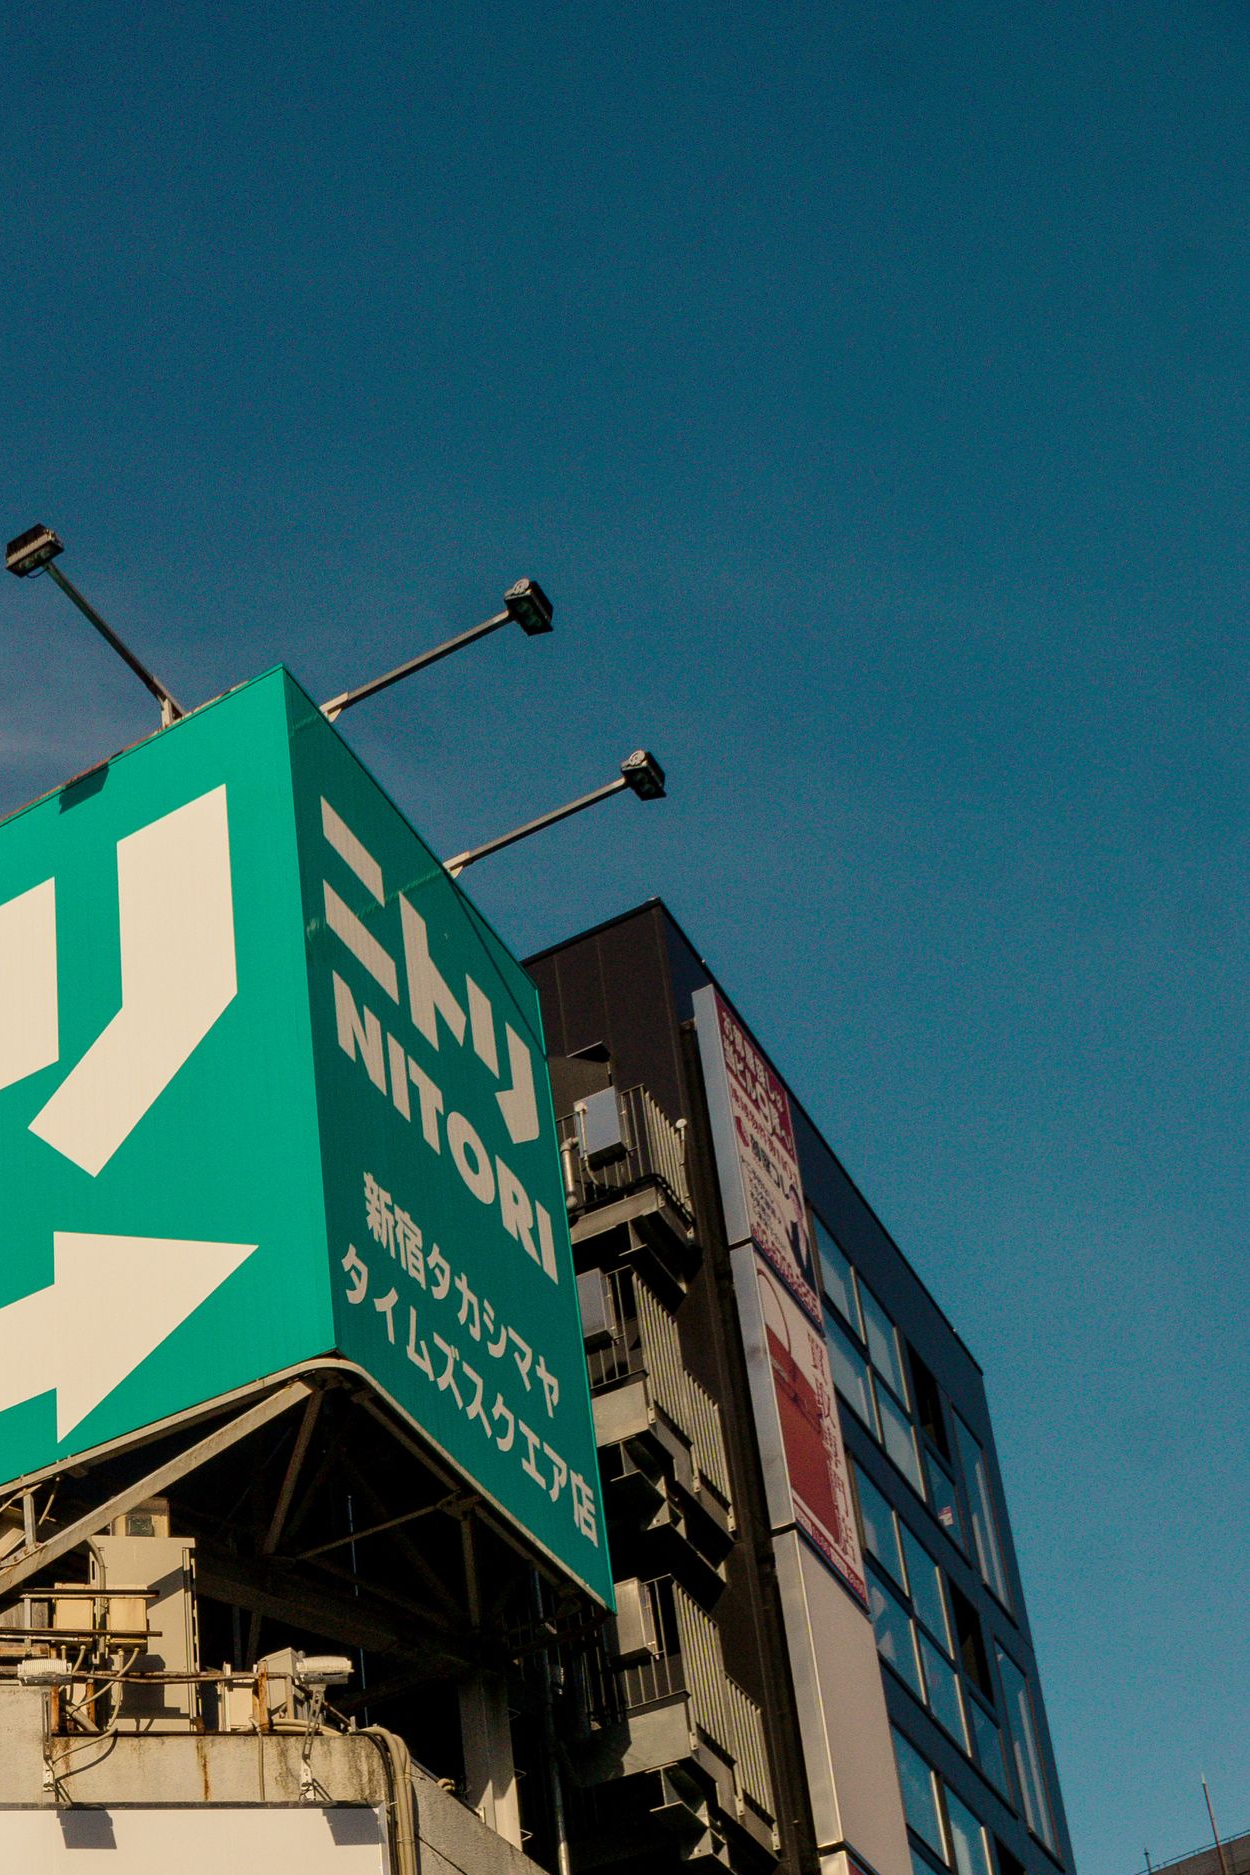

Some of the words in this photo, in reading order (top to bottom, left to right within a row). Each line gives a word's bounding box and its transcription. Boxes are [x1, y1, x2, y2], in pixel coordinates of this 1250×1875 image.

[319, 795, 540, 1145] ニトリ
[332, 968, 559, 1287] NITORI
[340, 1242, 599, 1549] タイムズスクエア店
[363, 1170, 560, 1419] 新宿タカシマヤ
